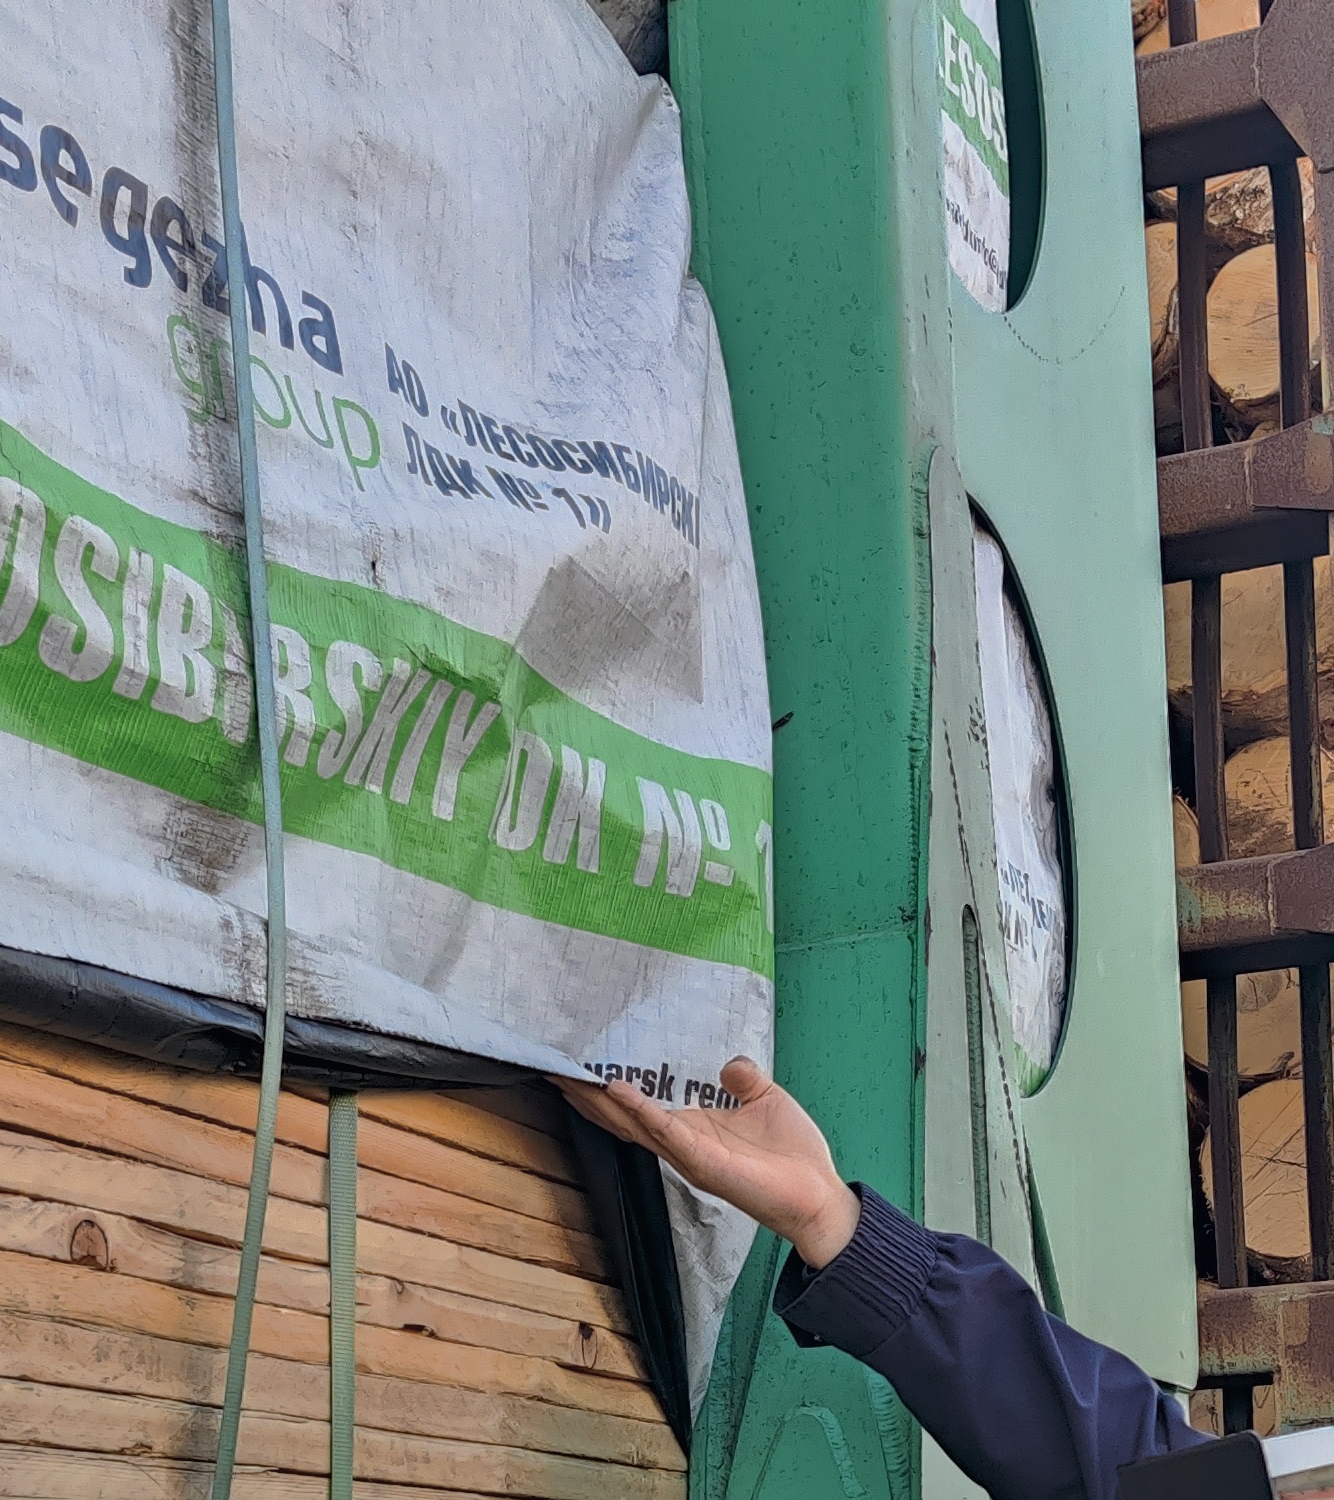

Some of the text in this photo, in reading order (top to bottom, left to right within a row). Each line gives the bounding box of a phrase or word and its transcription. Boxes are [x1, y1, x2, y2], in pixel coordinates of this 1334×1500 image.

[939, 14, 1008, 164] ESOS
[167, 314, 381, 493] group
[384, 341, 430, 418] АО
[401, 421, 496, 502] ЛДК
